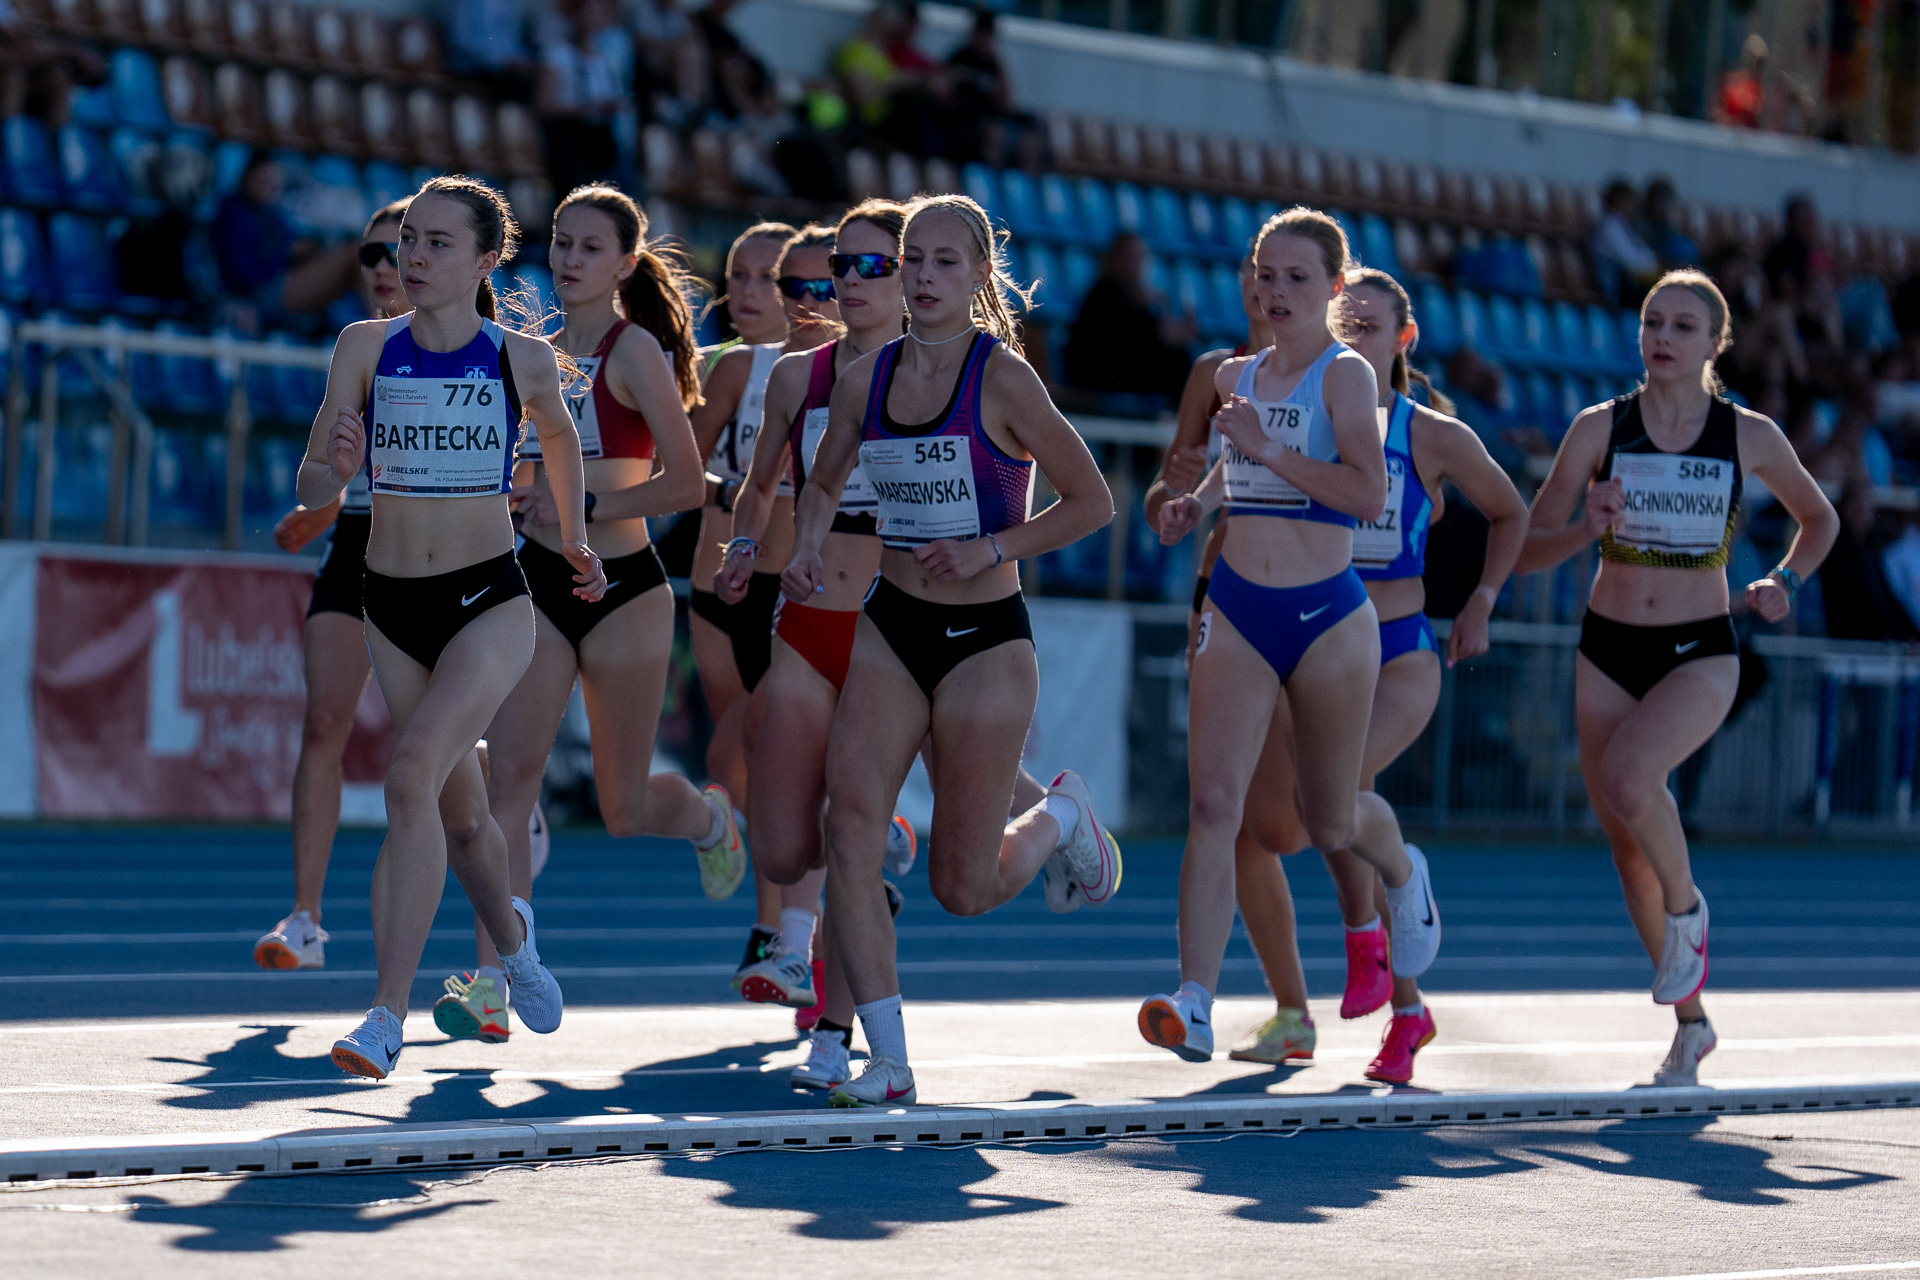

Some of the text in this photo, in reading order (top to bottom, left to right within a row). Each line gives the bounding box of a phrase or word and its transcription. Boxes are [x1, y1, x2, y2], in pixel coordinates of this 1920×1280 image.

[443, 384, 493, 407] 776
[1268, 407, 1300, 428] 778
[374, 423, 501, 451] BARTECKA
[915, 441, 957, 464] 545
[387, 465, 430, 475] LUBELSKIE
[387, 473, 405, 482] 2024
[1678, 461, 1721, 480] 584
[872, 477, 971, 505] MARSZEWSKA
[1624, 488, 1724, 517] ACHNIKOWSKA
